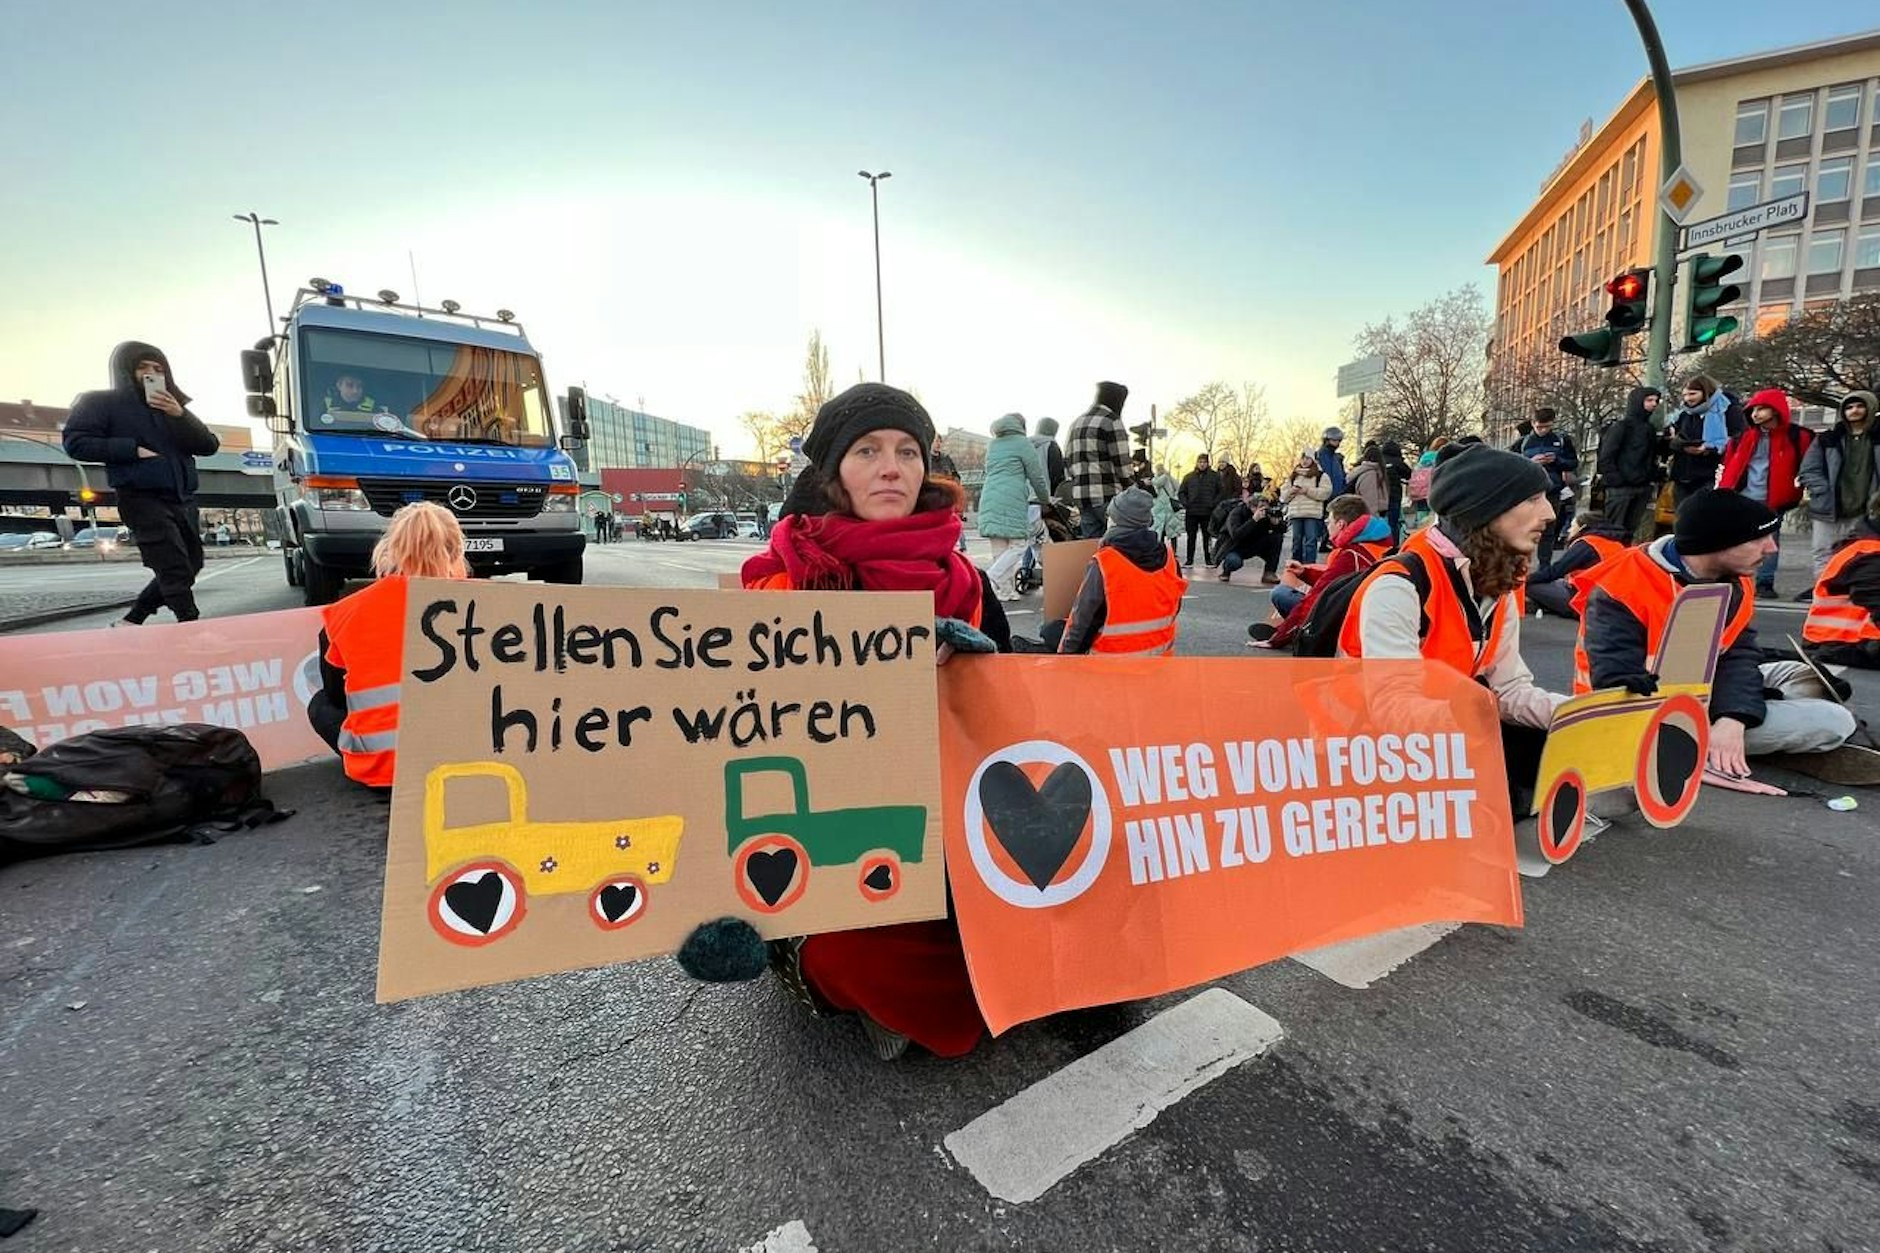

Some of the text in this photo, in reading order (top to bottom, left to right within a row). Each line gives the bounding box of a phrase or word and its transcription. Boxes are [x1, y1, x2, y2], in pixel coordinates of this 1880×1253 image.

[1691, 214, 1763, 241] Innsbrucker
[383, 444, 516, 459] POLIZEI
[465, 540, 494, 550] 7195
[411, 599, 930, 683] Stellen Sie sich vor
[492, 684, 876, 753] hier wären
[1108, 732, 1475, 808] WEG VON FOSSIL
[1124, 789, 1477, 886] HIN ZU GERECHT
